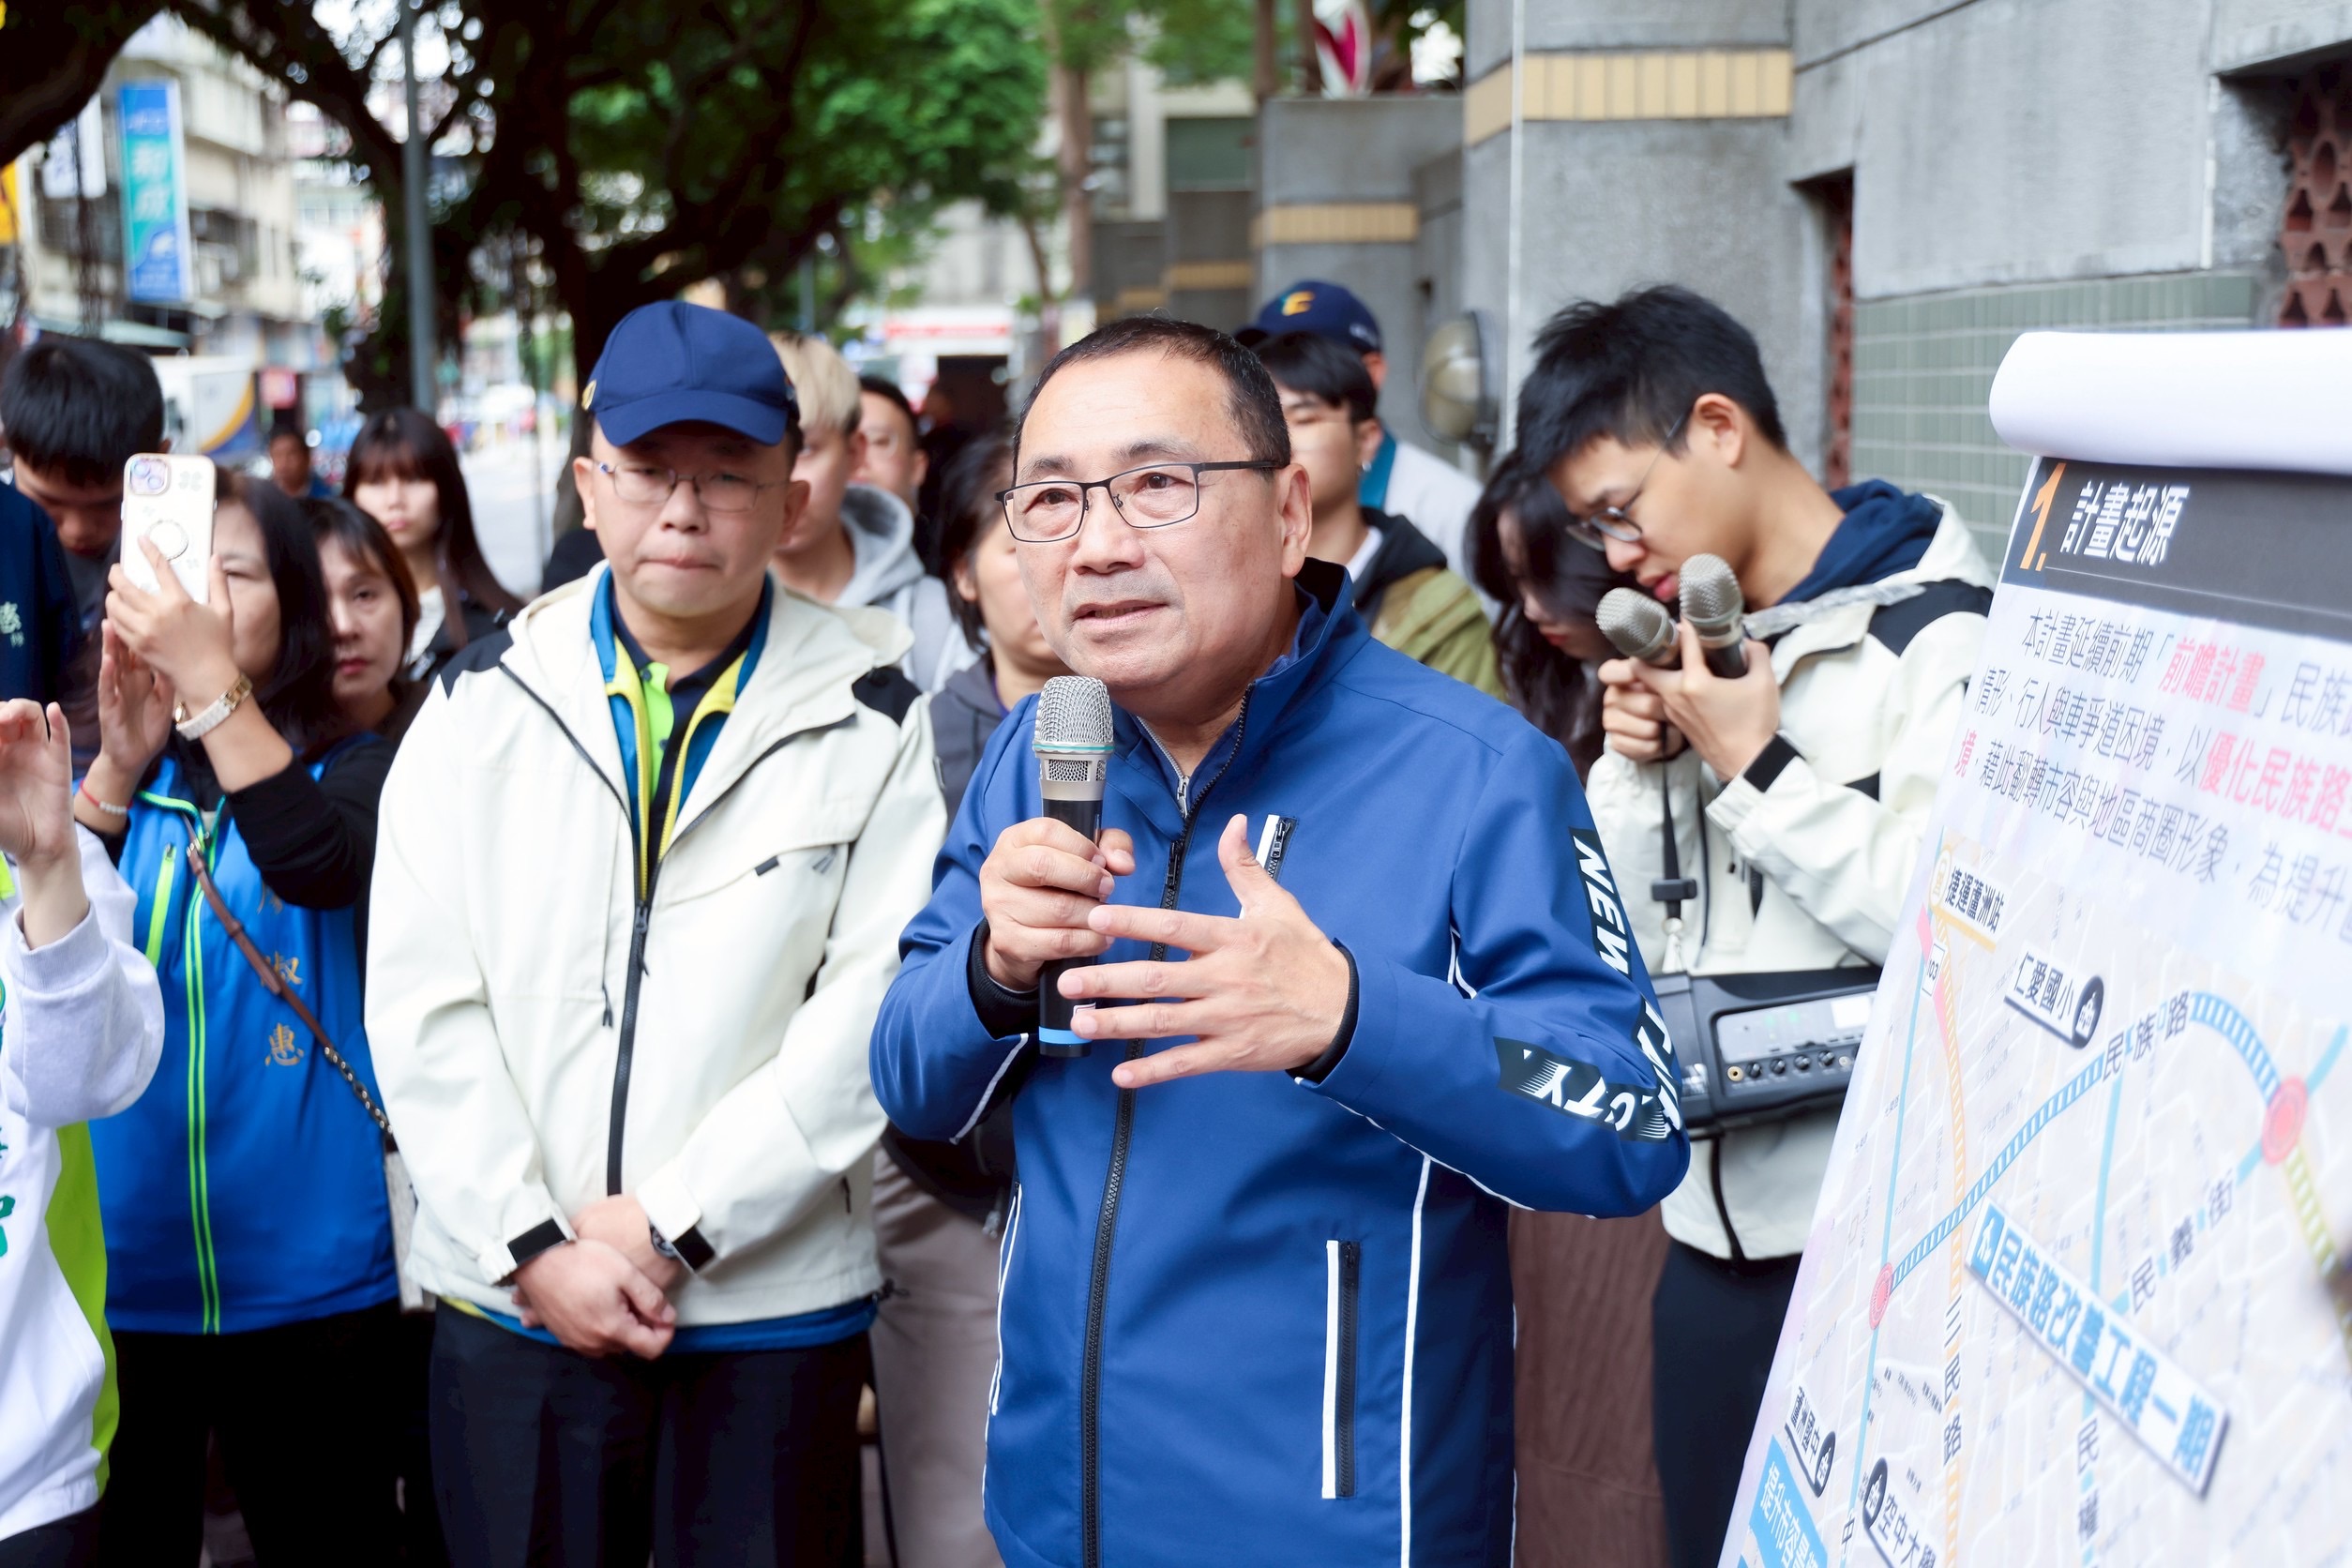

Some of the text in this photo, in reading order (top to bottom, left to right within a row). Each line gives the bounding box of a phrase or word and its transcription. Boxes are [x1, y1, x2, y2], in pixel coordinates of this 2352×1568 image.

[2019, 462, 2190, 571] 1. 計畫起源
[1573, 835, 1630, 976] NEW
[1944, 866, 2005, 933] 捷運蘆洲站
[2013, 951, 2075, 1020] 仁愛國小
[2103, 989, 2190, 1082] 民族路
[1943, 1293, 1962, 1466] 三民路
[1990, 1226, 2217, 1480] 民族路改善工程一期
[1759, 1460, 1821, 1568] 提升市容景
[2077, 1417, 2100, 1568] 民權
